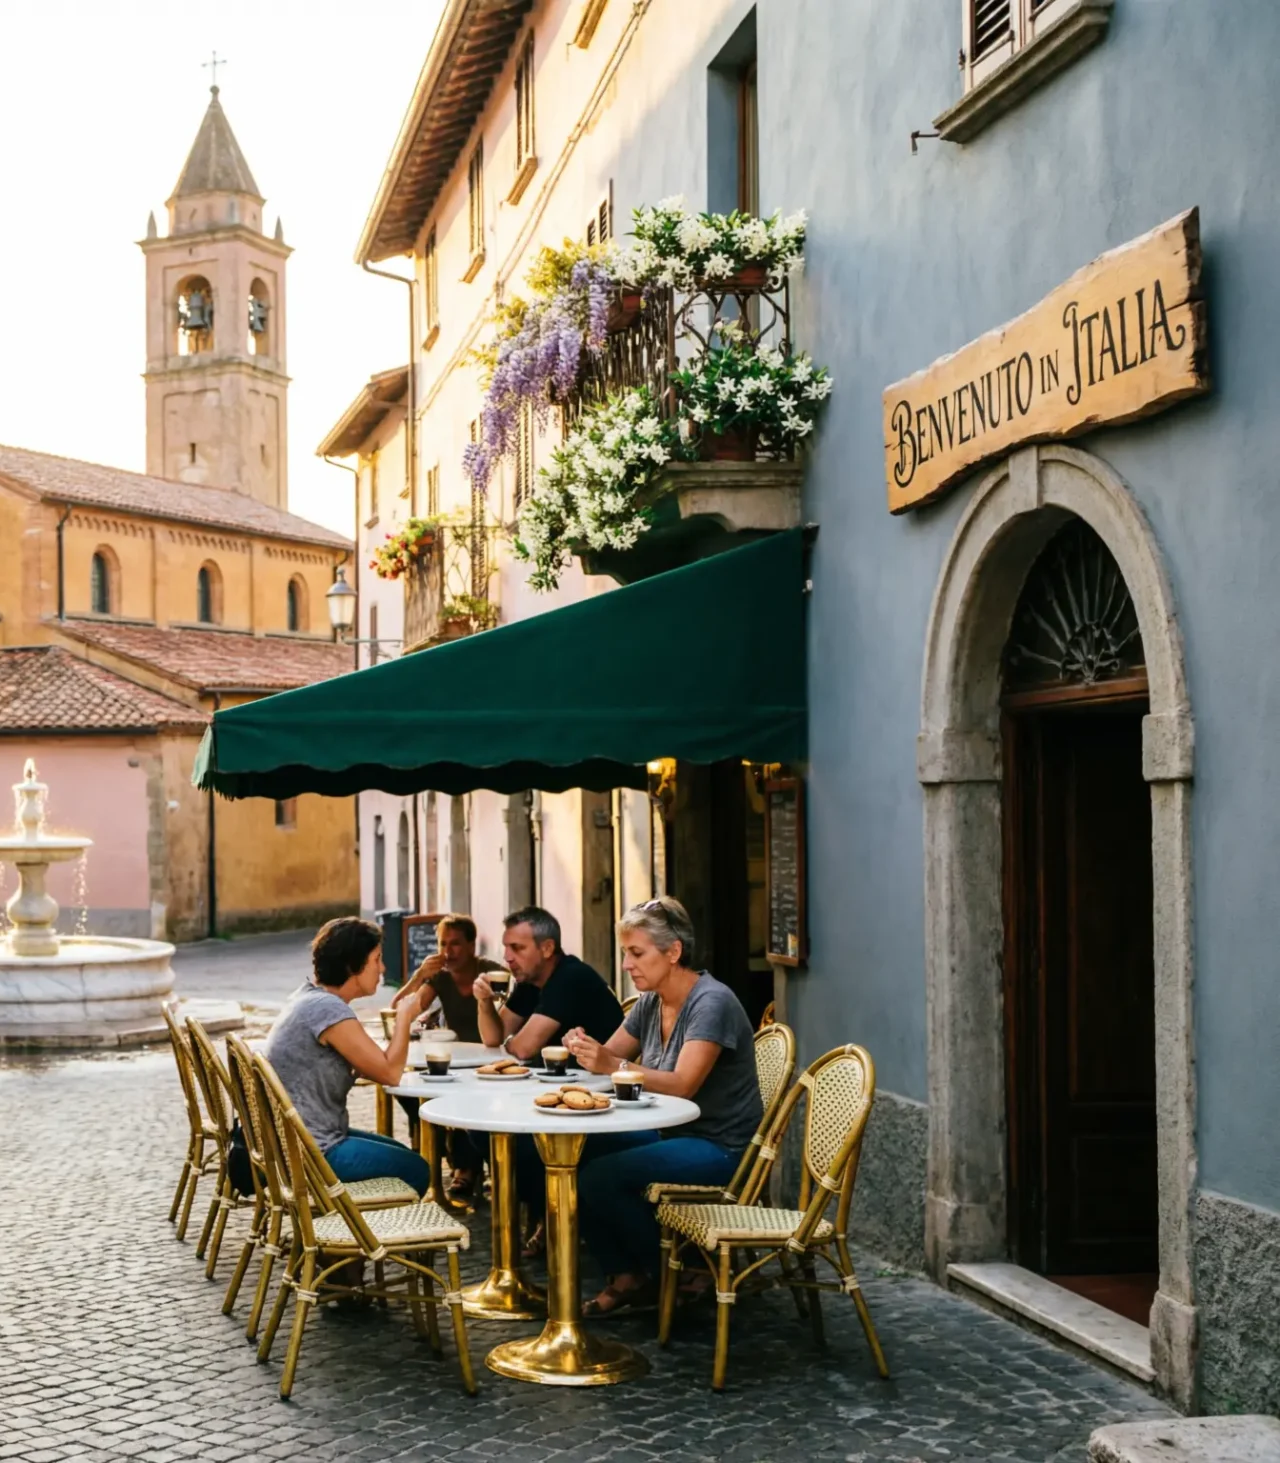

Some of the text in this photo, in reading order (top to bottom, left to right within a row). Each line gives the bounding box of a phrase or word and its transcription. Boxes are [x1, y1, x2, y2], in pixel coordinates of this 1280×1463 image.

[892, 279, 1185, 487] BENVENUTO IN ITALIA
